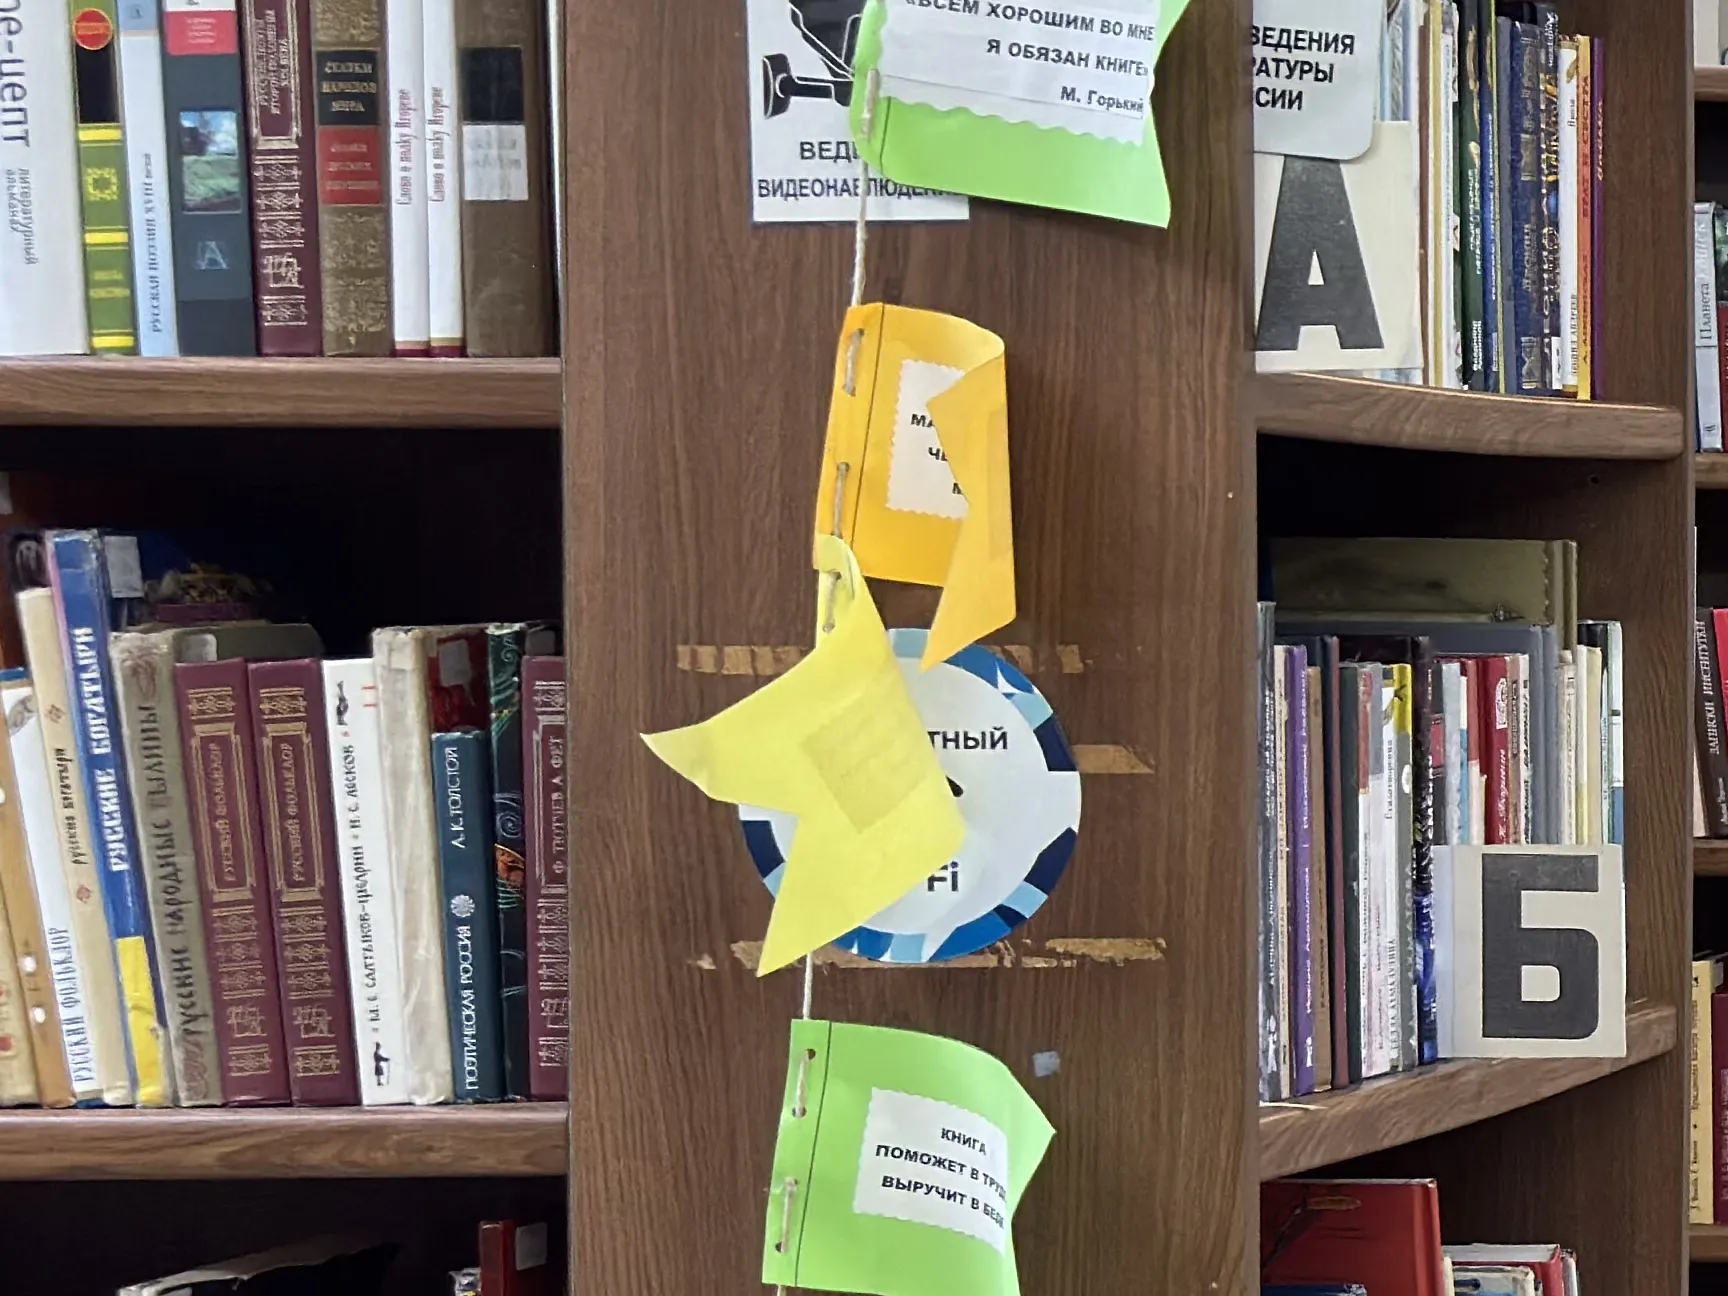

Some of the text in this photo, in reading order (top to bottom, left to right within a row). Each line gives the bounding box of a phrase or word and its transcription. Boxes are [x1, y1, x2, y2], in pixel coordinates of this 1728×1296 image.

[986, 2, 1095, 34] ХОРОШИМ
[1099, 19, 1123, 38] ВО
[1127, 23, 1155, 42] МНЕ
[986, 38, 1150, 78] Я ОБЯЗАН КНИГЕ»
[1060, 84, 1144, 115] М. Горький
[1257, 157, 1384, 351] А
[70, 626, 129, 872] РУССКИЕ БОГАТЫРИ
[1481, 852, 1600, 1040] Б
[457, 925, 480, 1091] ПОЭТИЧЕСКАЯ РОССИЯ
[941, 1127, 987, 1156] КНИГА
[875, 1144, 979, 1180] ПОМОЖЕТ В
[881, 1175, 979, 1210] ВЫРУЧИТ В
